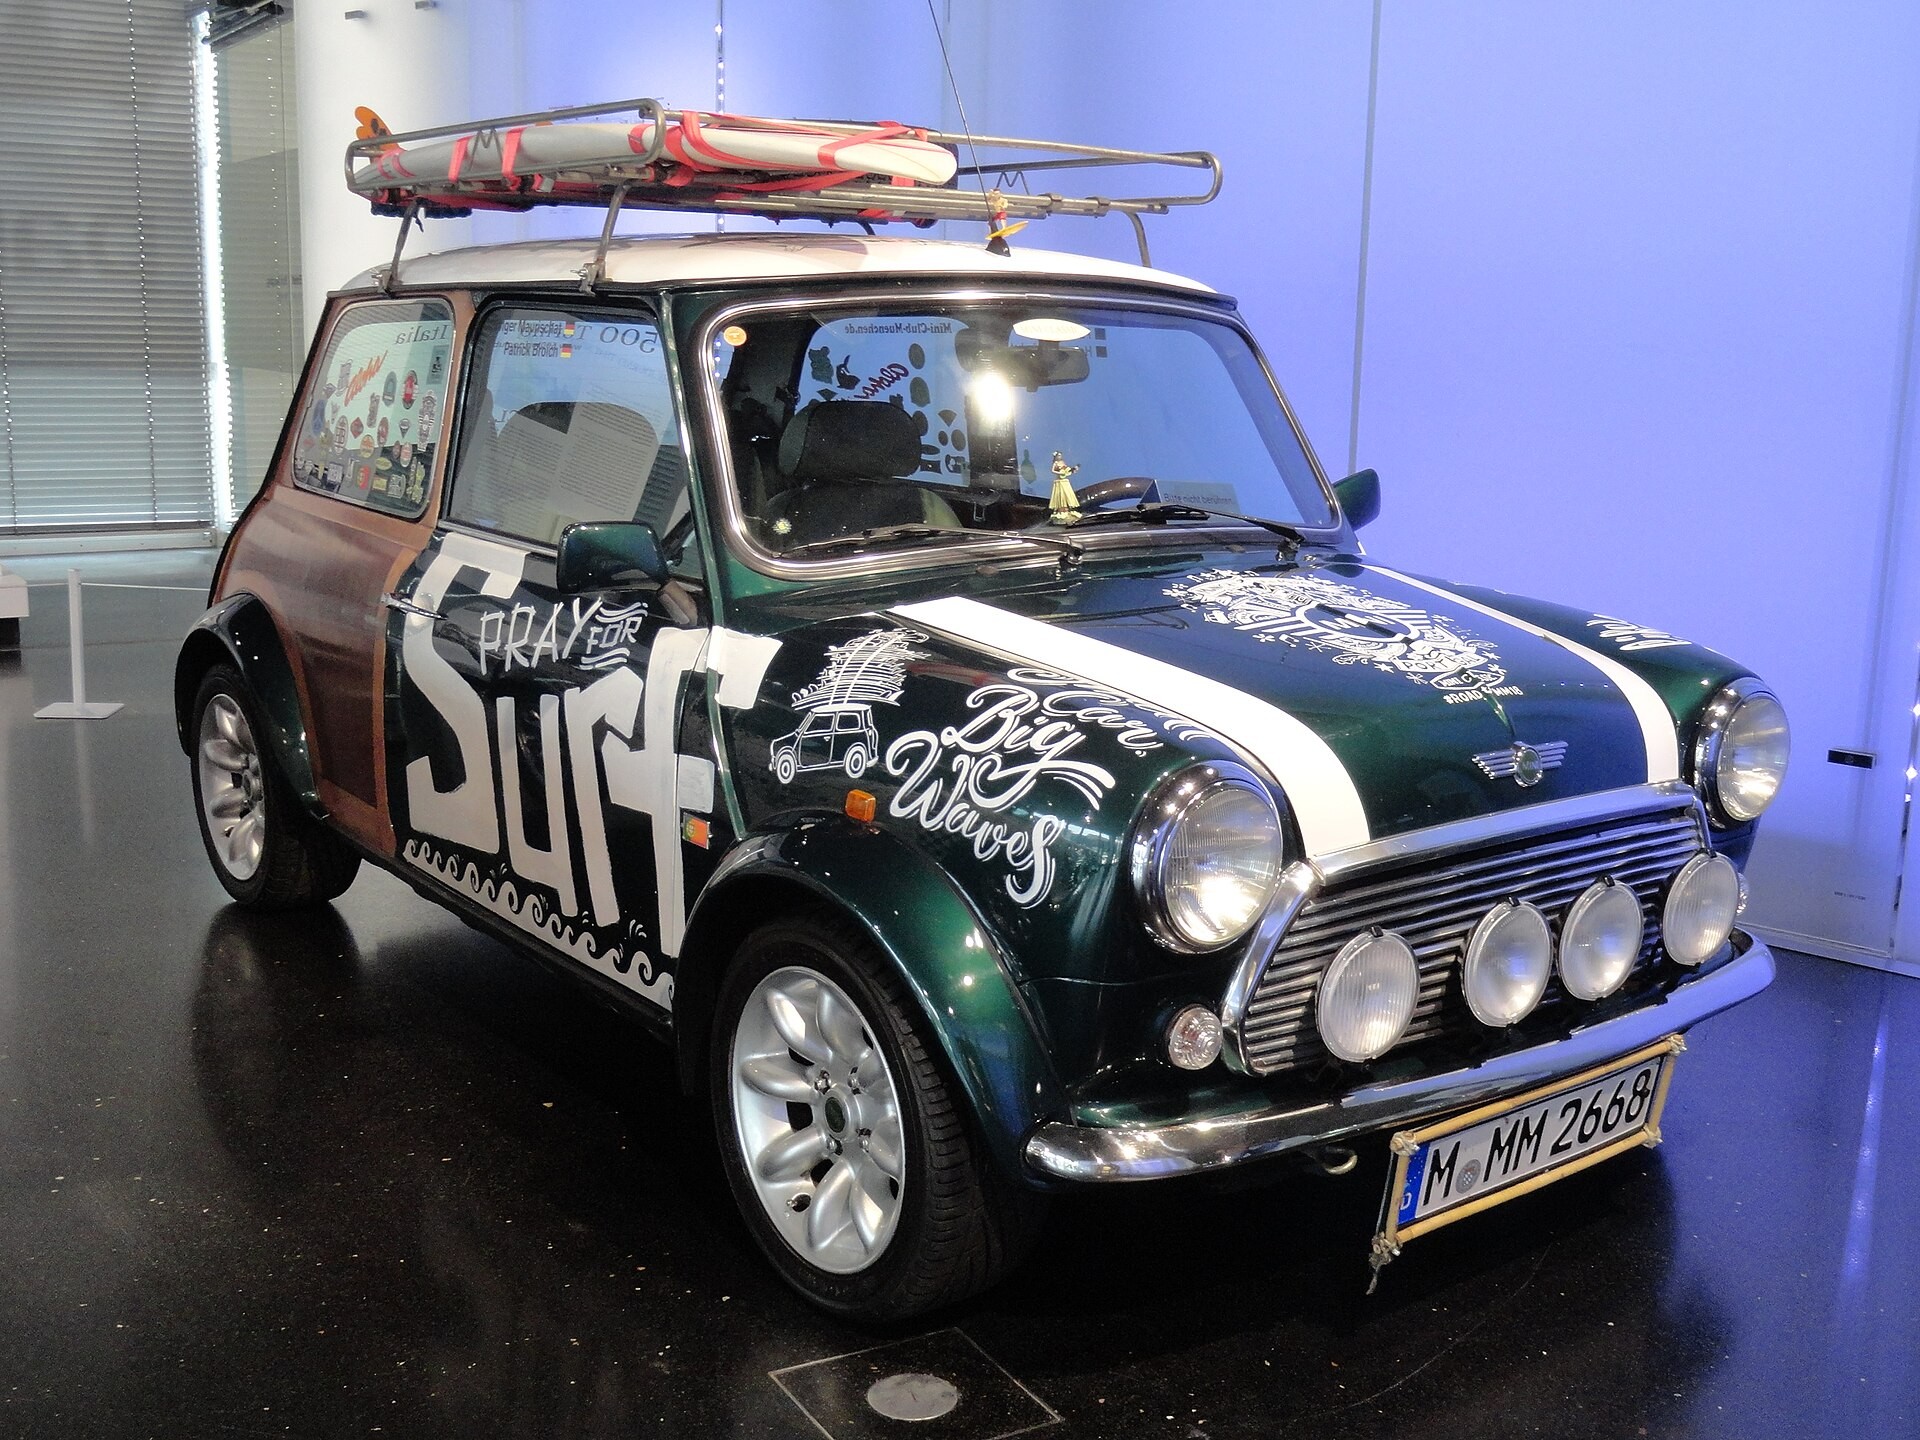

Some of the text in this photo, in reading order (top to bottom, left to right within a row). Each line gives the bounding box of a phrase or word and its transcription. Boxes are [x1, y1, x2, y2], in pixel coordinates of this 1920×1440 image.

[503, 341, 531, 356] Patrick
[1164, 493, 1182, 504] Bitte
[1183, 495, 1201, 504] nicht
[481, 597, 642, 674] PRAY FOR
[942, 684, 1115, 812] Big
[1423, 1068, 1651, 1206] M MM 2668
